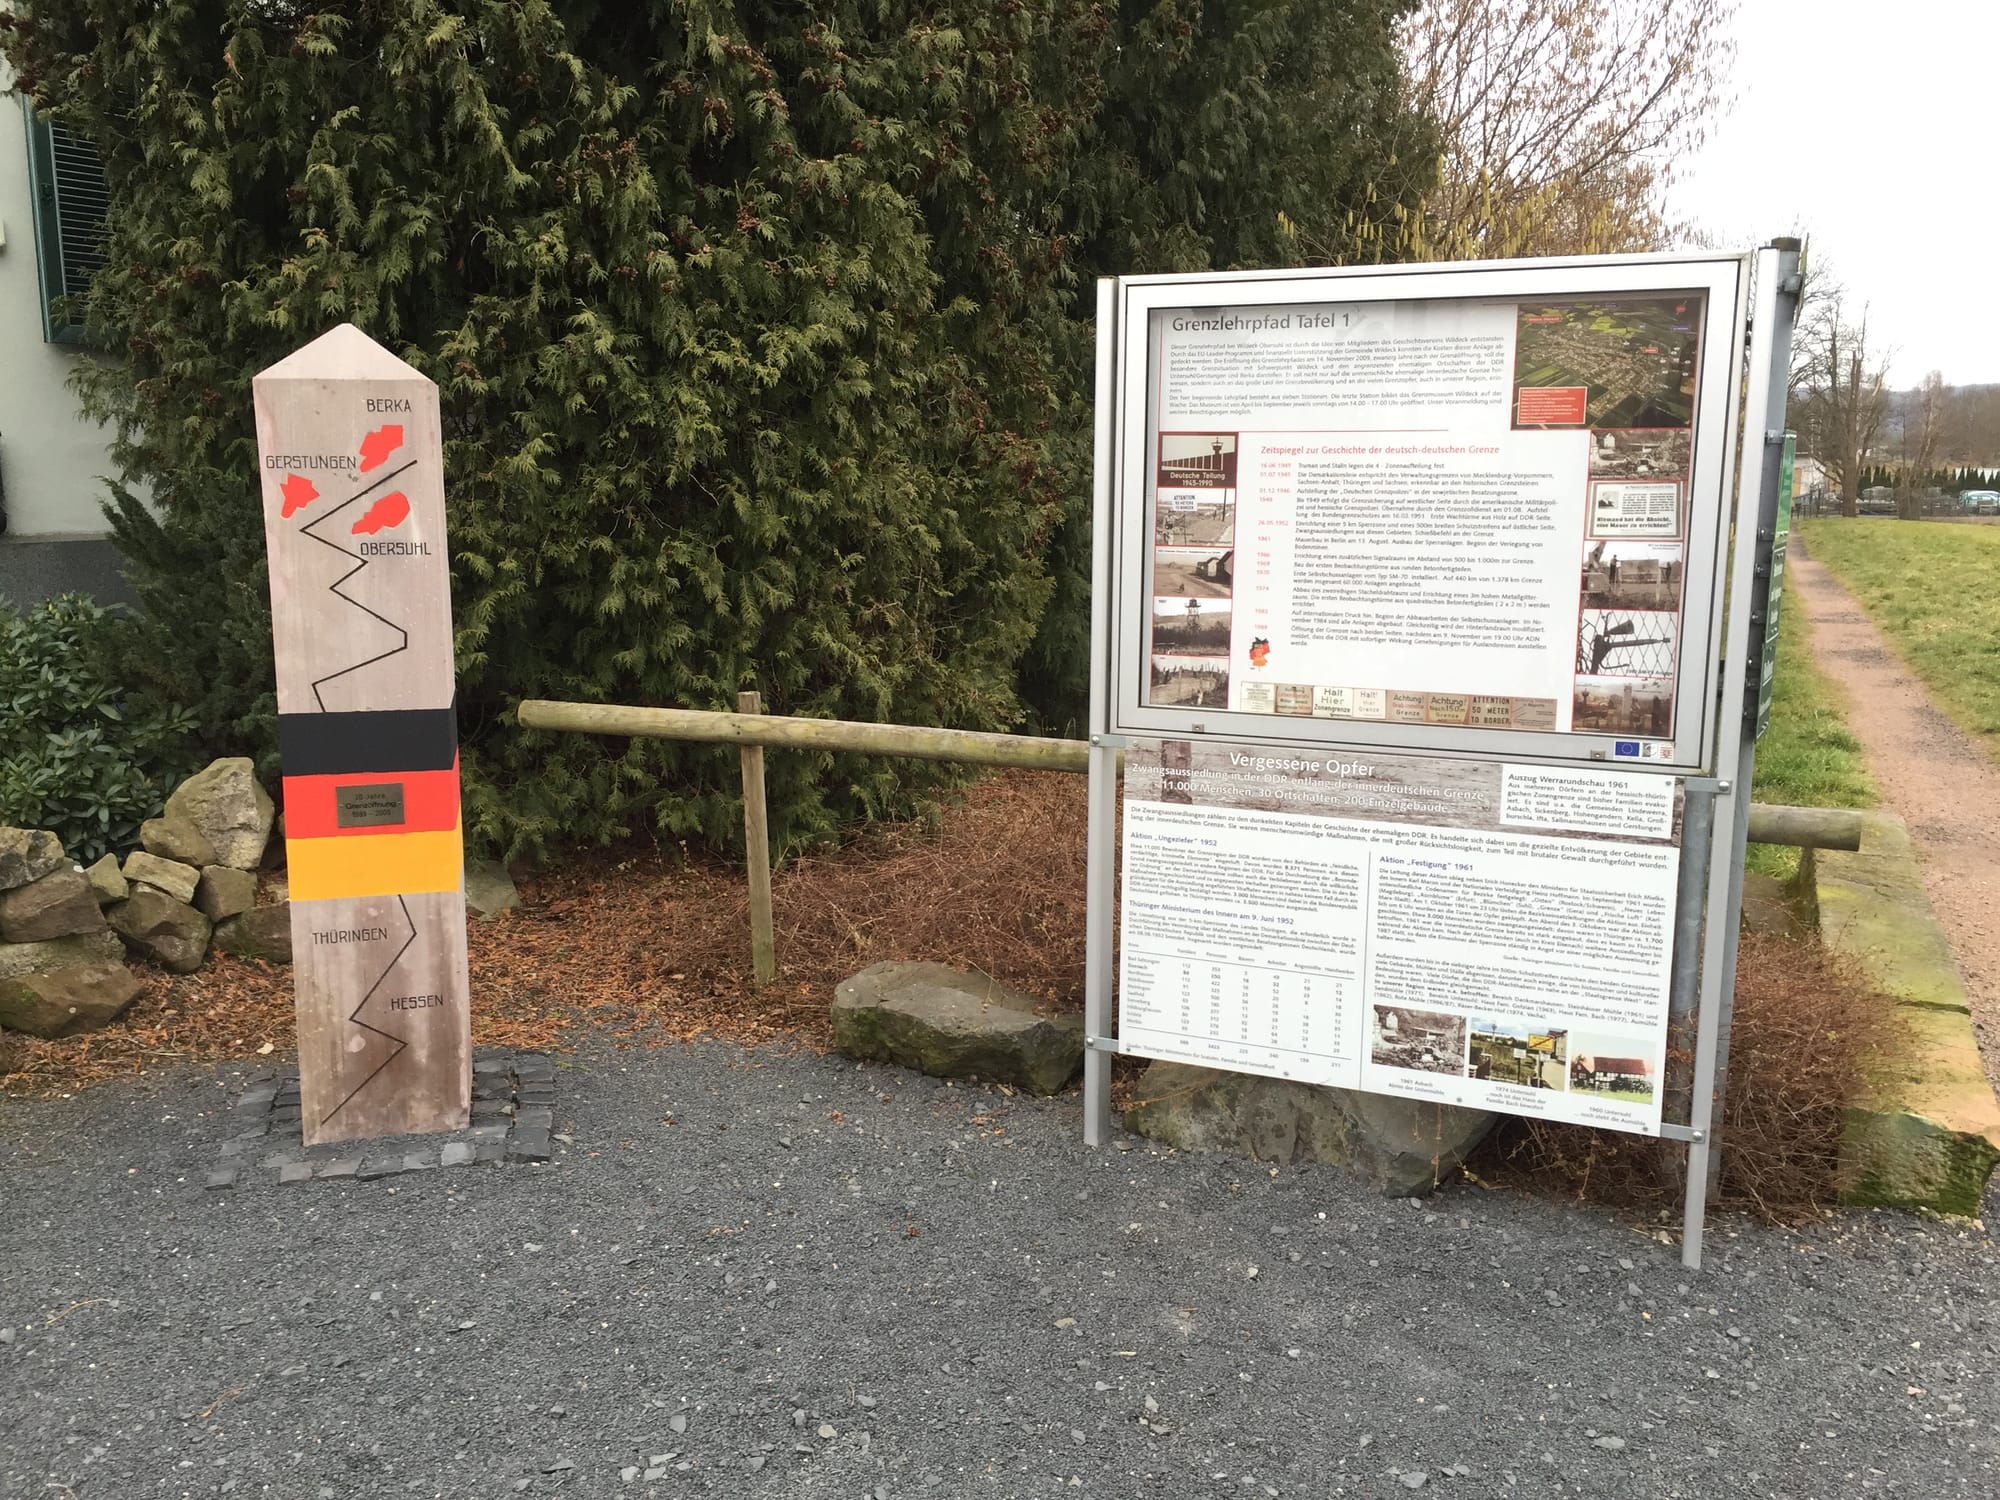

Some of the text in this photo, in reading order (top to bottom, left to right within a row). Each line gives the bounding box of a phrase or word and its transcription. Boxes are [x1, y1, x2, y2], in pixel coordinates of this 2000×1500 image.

[1173, 312, 1349, 333] Grenzlehrpfad Tafel 1
[367, 399, 412, 412] BERKA
[1261, 446, 1303, 455] Zeitspiegel
[1322, 446, 1366, 454] Geschichte
[1369, 446, 1382, 454] der
[1385, 445, 1465, 454] deutsch-deutschen
[1469, 446, 1499, 454] Grenze
[266, 456, 356, 469] GERSTUNGEN
[360, 542, 431, 555] OBERSUHL
[1324, 688, 1343, 696] Halt
[1314, 704, 1350, 713] Zonengrenze
[1230, 752, 1375, 777] Vergessene Opfer
[1133, 763, 1230, 780] Zwangsaussiedlung
[1244, 774, 1260, 782] der
[1264, 774, 1287, 783] DDR
[1291, 778, 1329, 789] entlang
[1335, 779, 1351, 789] der
[1355, 782, 1439, 796] innerdeutschen
[1443, 788, 1484, 800] Grenze
[1508, 774, 1628, 789] Auszug Werrarundschau 1961
[1162, 780, 1196, 791] 11.000
[1259, 789, 1271, 797] 30
[1345, 796, 1366, 806] 200
[1368, 798, 1448, 813] Einzelgebäude
[1533, 792, 1574, 801] Zonengrenze
[1586, 804, 1623, 812] Gemeinden
[1131, 832, 1152, 840] Aktion
[1131, 814, 1143, 822] lang
[1157, 817, 1201, 826] innerdeutschen
[1260, 825, 1324, 838] menschenunwürdige
[1395, 839, 1417, 847] großer
[1531, 851, 1558, 859] brutaler
[1561, 854, 1586, 862] Gewalt
[1589, 856, 1636, 868] durchgeführt
[1142, 808, 1205, 820] Zwangsaussiedlungen
[1207, 813, 1226, 821] zählen
[1249, 817, 1283, 826] dunkelsten
[1285, 820, 1311, 830] Kapiteln
[1324, 823, 1358, 833] Geschichte
[1372, 828, 1409, 839] ehemaligen
[1440, 834, 1468, 843] handelte
[1531, 842, 1559, 852] gezielte
[1561, 845, 1607, 857] Entvölkerung
[1624, 851, 1652, 859] Gebiete
[1380, 856, 1404, 864] Aktion
[1455, 863, 1473, 871] 1961
[1130, 900, 1160, 910] Thüringer
[1161, 904, 1201, 914] Ministerium
[1261, 915, 1274, 923] Juni
[1277, 917, 1294, 925] 1952
[313, 928, 387, 945] THÜRINGEN
[391, 995, 444, 1011] HESSEN
